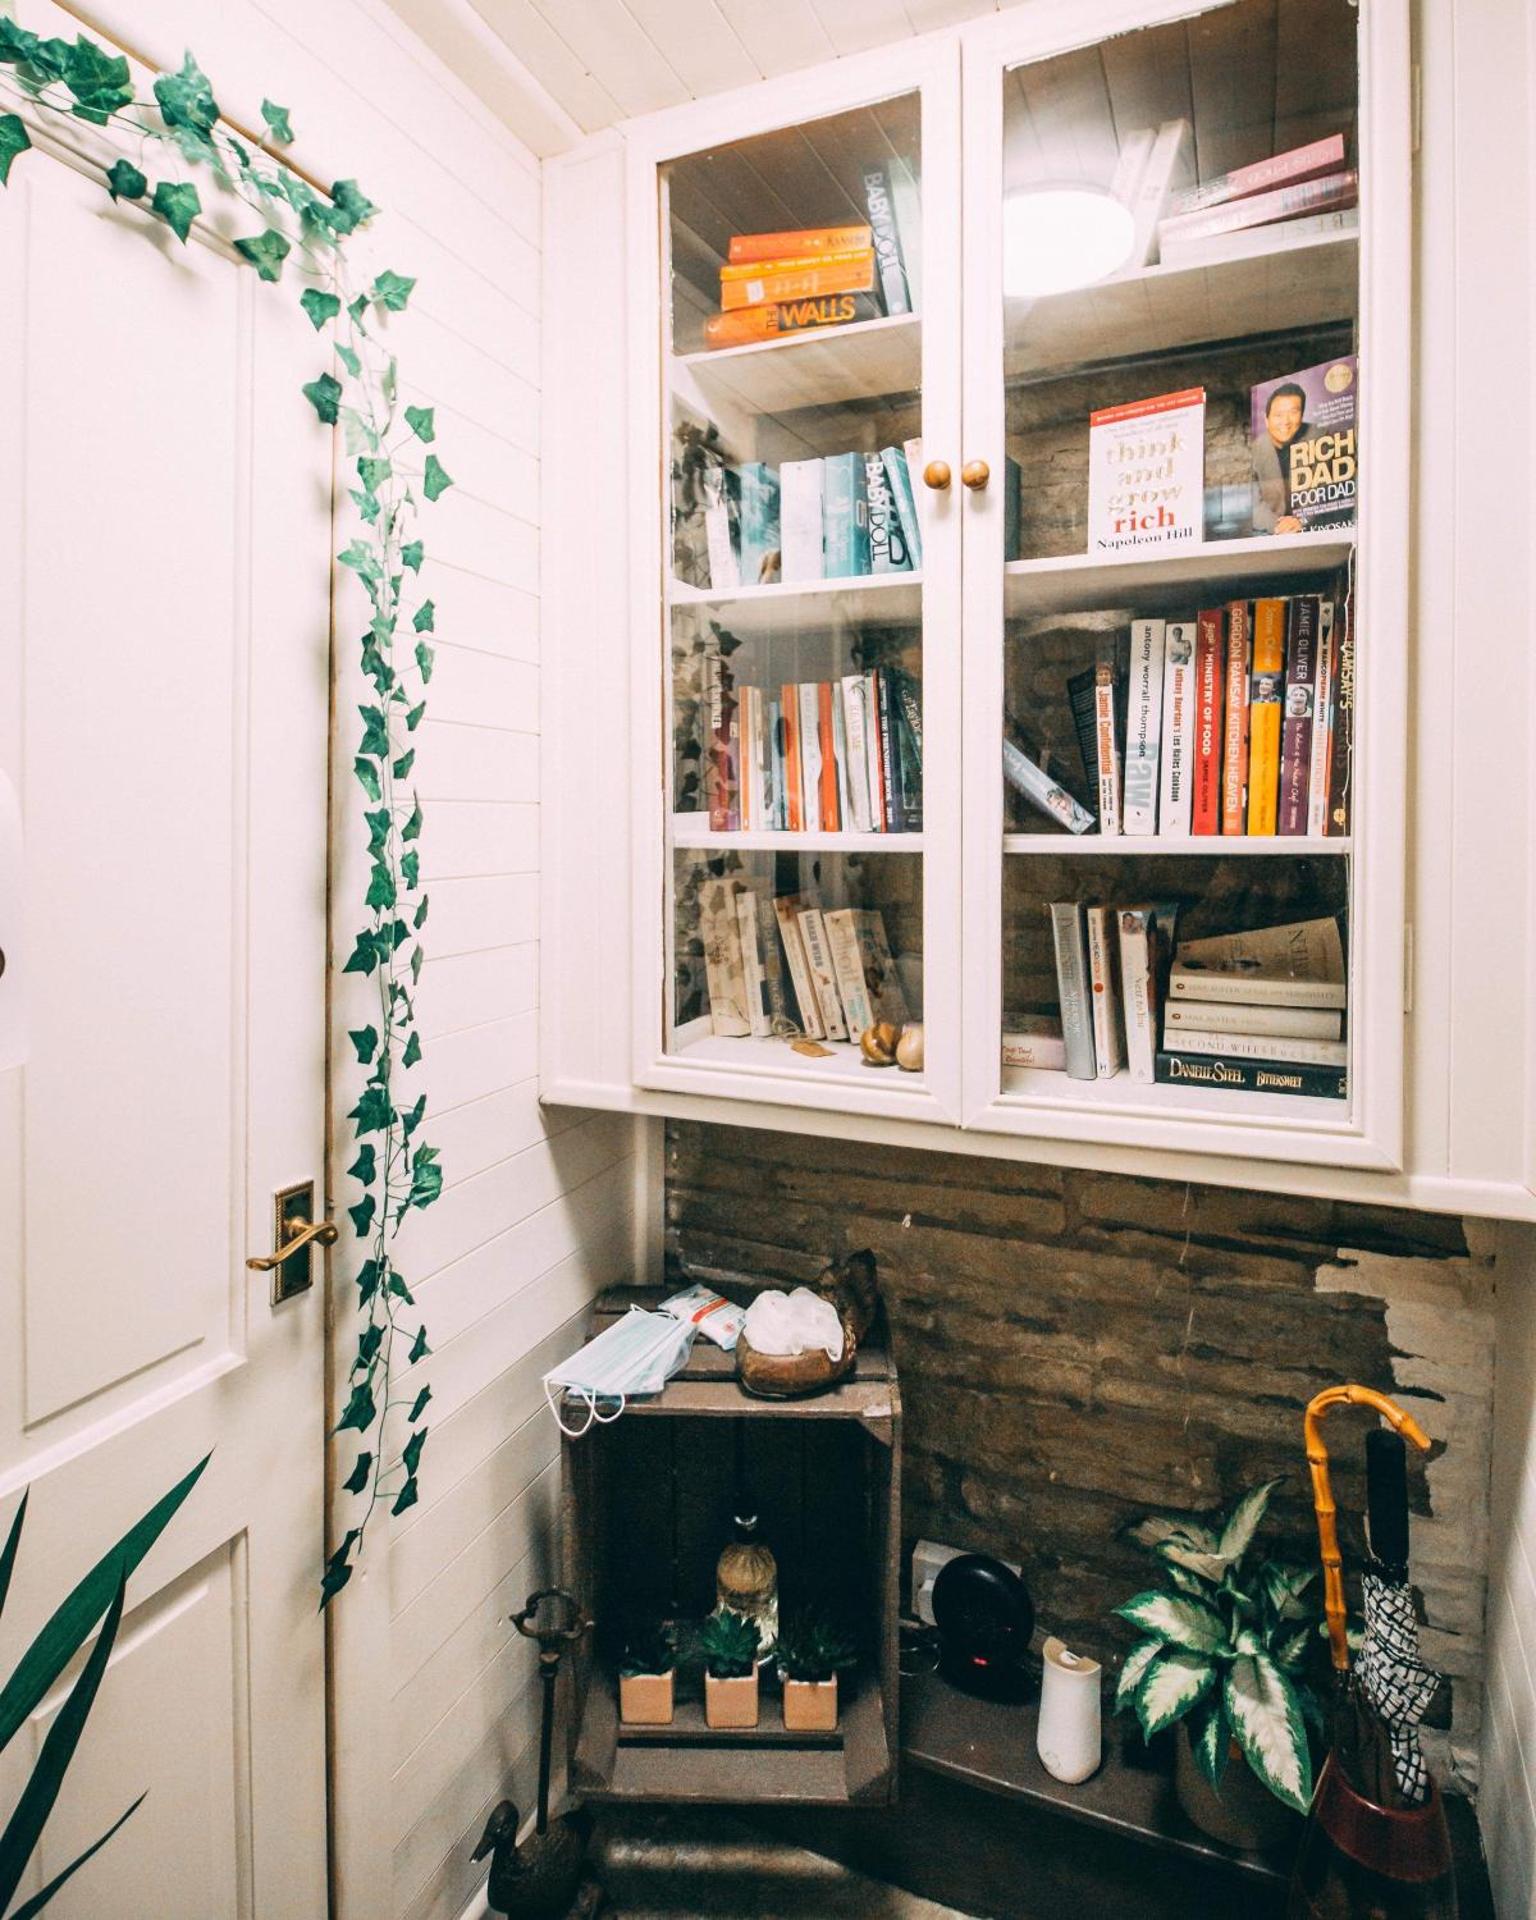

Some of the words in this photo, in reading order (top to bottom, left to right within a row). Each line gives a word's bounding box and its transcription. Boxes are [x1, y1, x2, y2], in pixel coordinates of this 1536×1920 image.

[782, 295, 855, 327] WALLS
[1107, 432, 1184, 465] think
[1290, 429, 1355, 469] RICH
[1291, 455, 1356, 492] DAD
[1291, 487, 1326, 508] POOR
[1328, 480, 1356, 500] DAD
[1115, 505, 1175, 533] rich
[1097, 535, 1162, 550] Napoleon
[1167, 527, 1193, 540] Hill
[1231, 608, 1242, 658] GORDON
[1300, 603, 1311, 636] JAMIE
[1141, 625, 1151, 661] antony
[1297, 640, 1310, 680] OLIVER
[1142, 665, 1150, 701] worrall
[1204, 654, 1214, 705] MINISTRY
[1230, 661, 1241, 709] RAMSAY
[1138, 705, 1149, 757] thompson
[1203, 707, 1212, 723] OF
[1202, 724, 1212, 757] FOOD
[1229, 711, 1240, 764] KITCHEN
[1227, 766, 1239, 813] HEAVEN
[1170, 1057, 1213, 1080] DANIELLE
[1214, 1061, 1246, 1083] STEEL
[1256, 1070, 1302, 1088] BITTERSWEET
